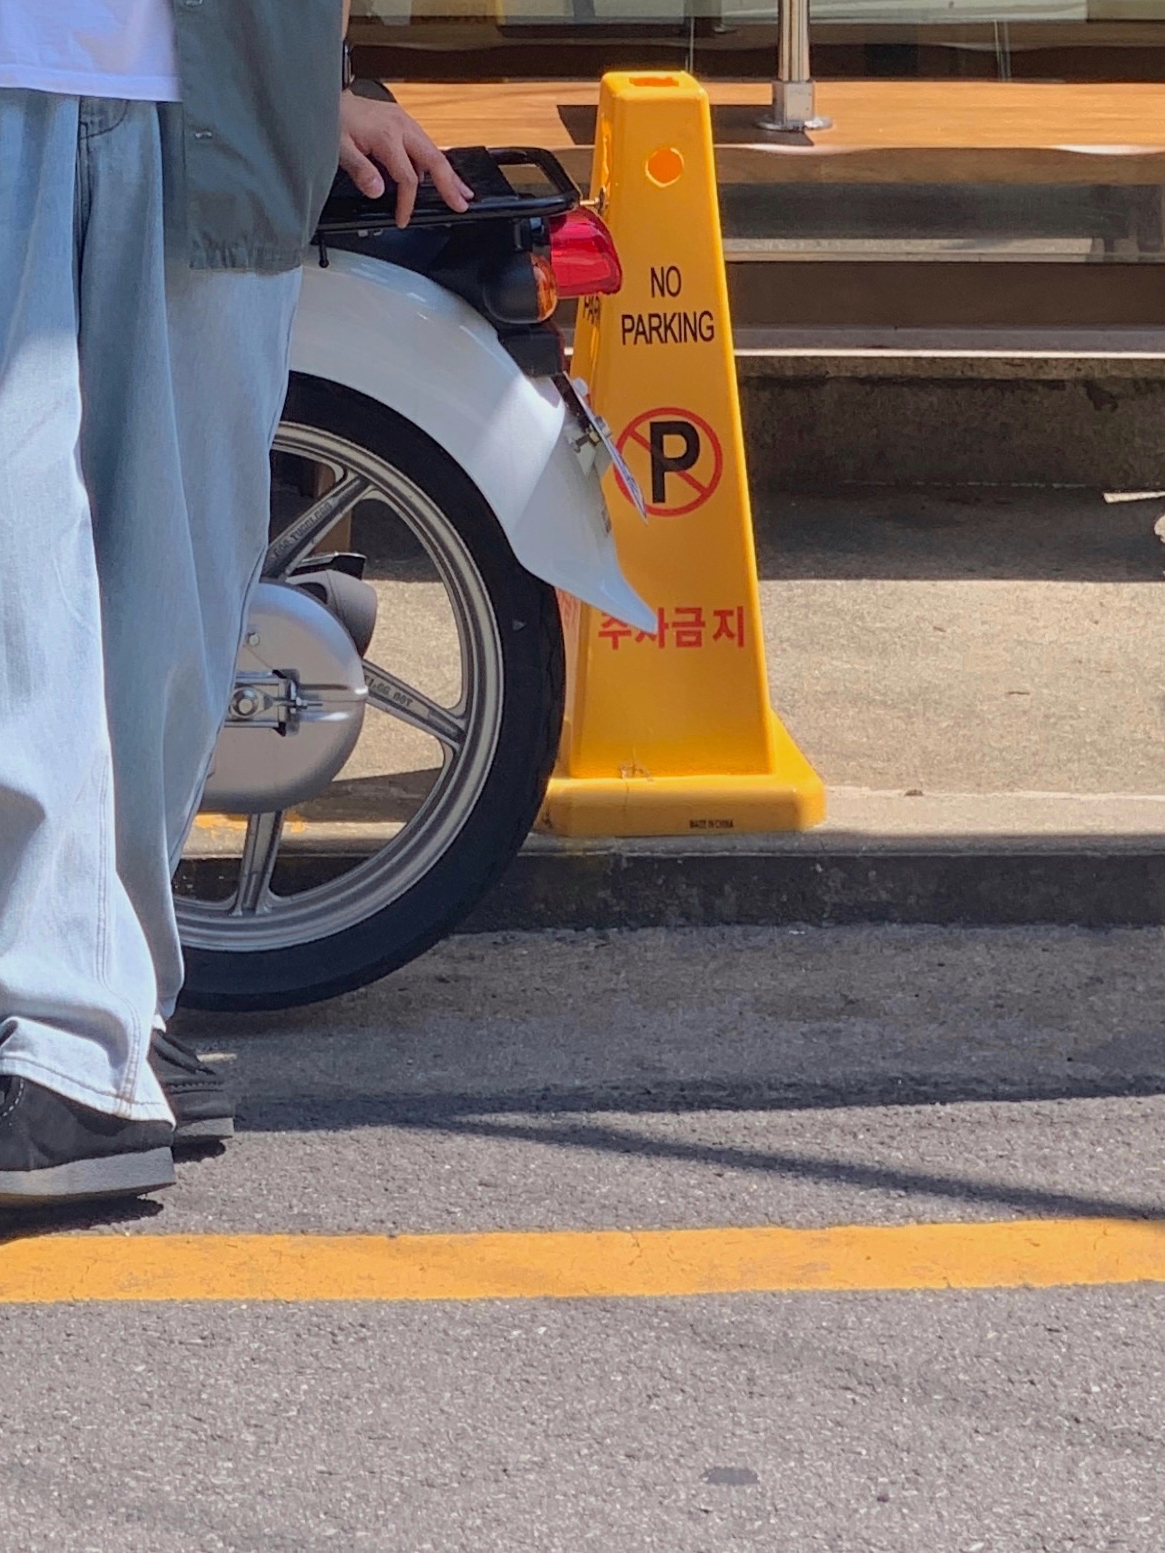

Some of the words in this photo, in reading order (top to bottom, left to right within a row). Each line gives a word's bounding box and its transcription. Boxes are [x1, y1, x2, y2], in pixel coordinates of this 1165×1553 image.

[650, 265, 682, 298] NO
[621, 310, 715, 346] PARKING
[649, 420, 702, 504] P
